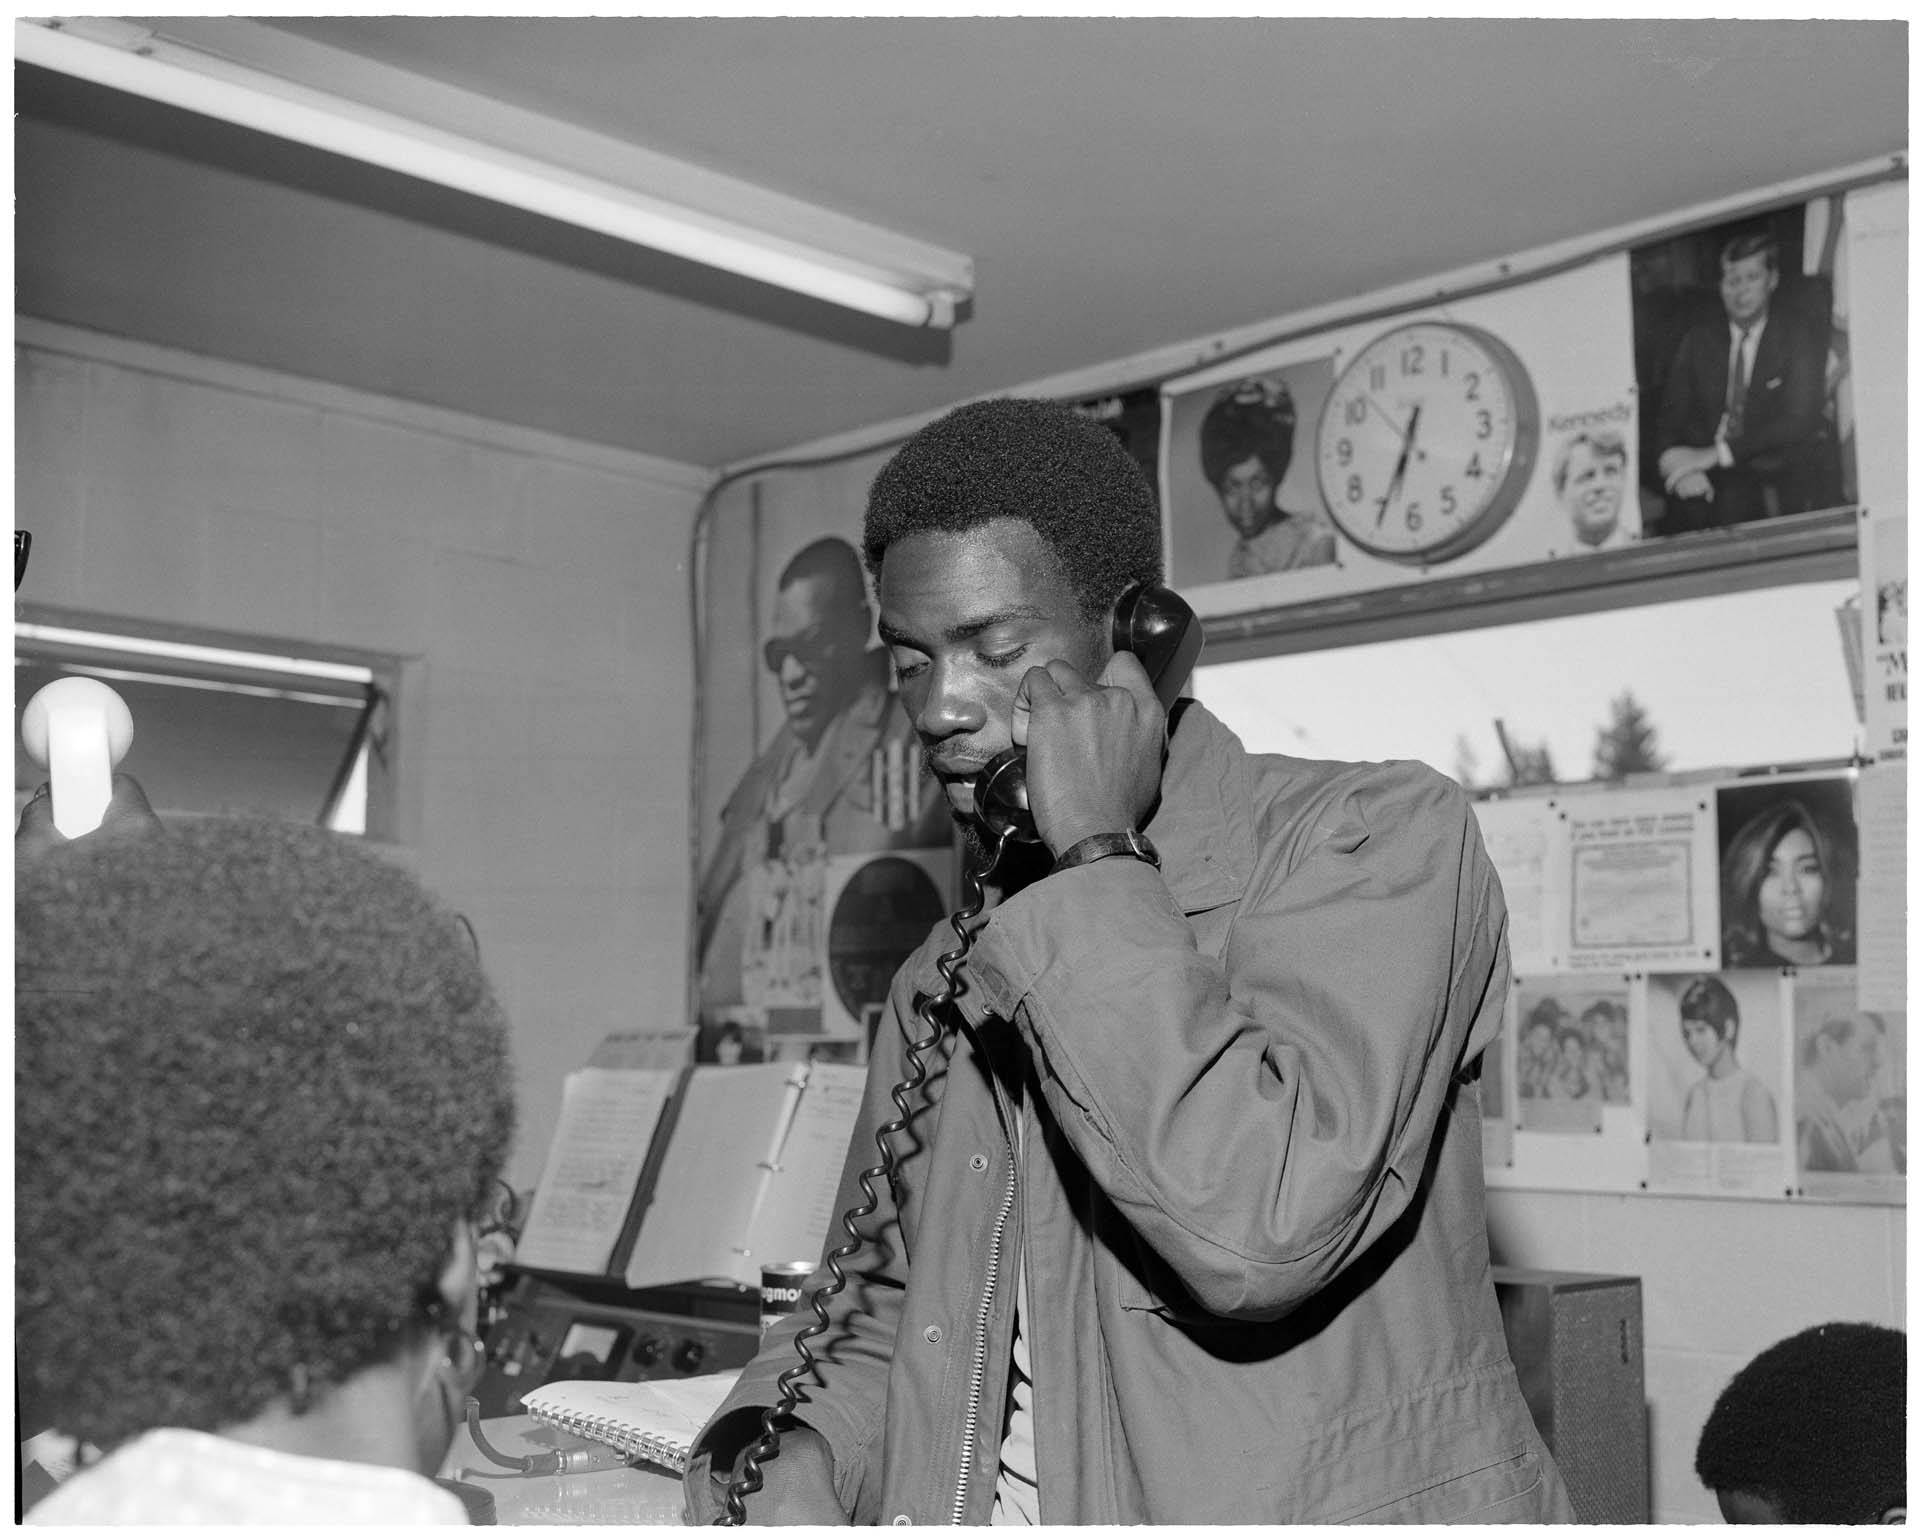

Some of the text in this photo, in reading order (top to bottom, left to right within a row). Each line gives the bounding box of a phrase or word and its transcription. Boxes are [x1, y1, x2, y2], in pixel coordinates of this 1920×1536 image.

[1402, 346, 1423, 376] 12
[1440, 349, 1449, 376] 1
[1369, 365, 1386, 392] 11
[1464, 371, 1480, 401] 2
[1345, 397, 1367, 426] 10
[1476, 409, 1492, 439] 3
[1337, 437, 1353, 467] 9
[1464, 452, 1482, 478] 4
[1347, 474, 1363, 503] 8
[1440, 486, 1456, 515] 5
[1405, 503, 1422, 531] 6
